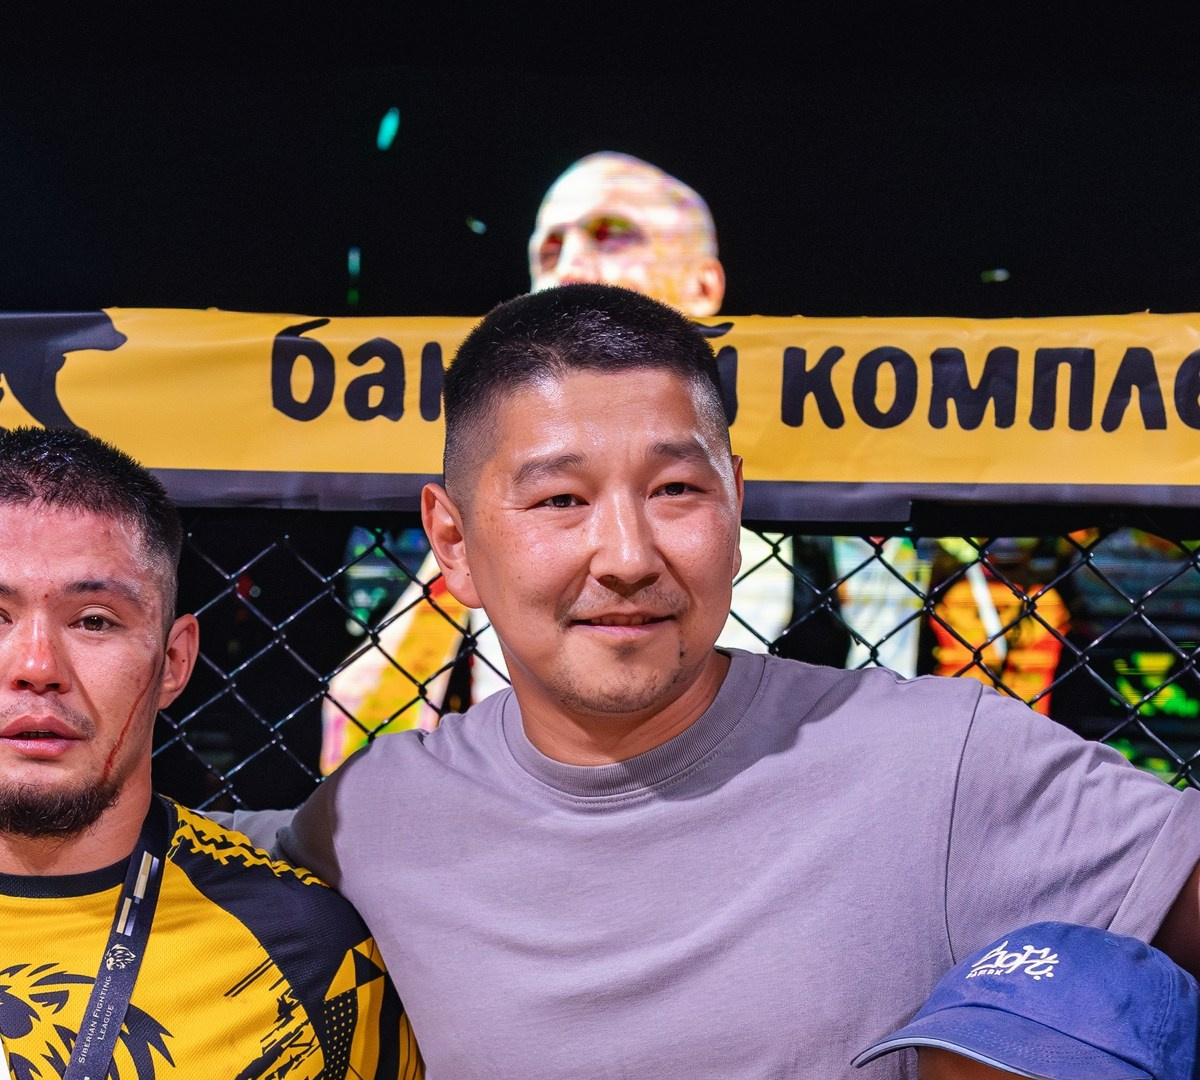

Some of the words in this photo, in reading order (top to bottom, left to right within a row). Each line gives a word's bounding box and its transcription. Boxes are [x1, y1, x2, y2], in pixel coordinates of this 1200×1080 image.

[78, 1022, 98, 1064] SIBERIAN
[92, 976, 112, 1018] FIGHTING
[97, 1005, 115, 1041] LEAGUE
